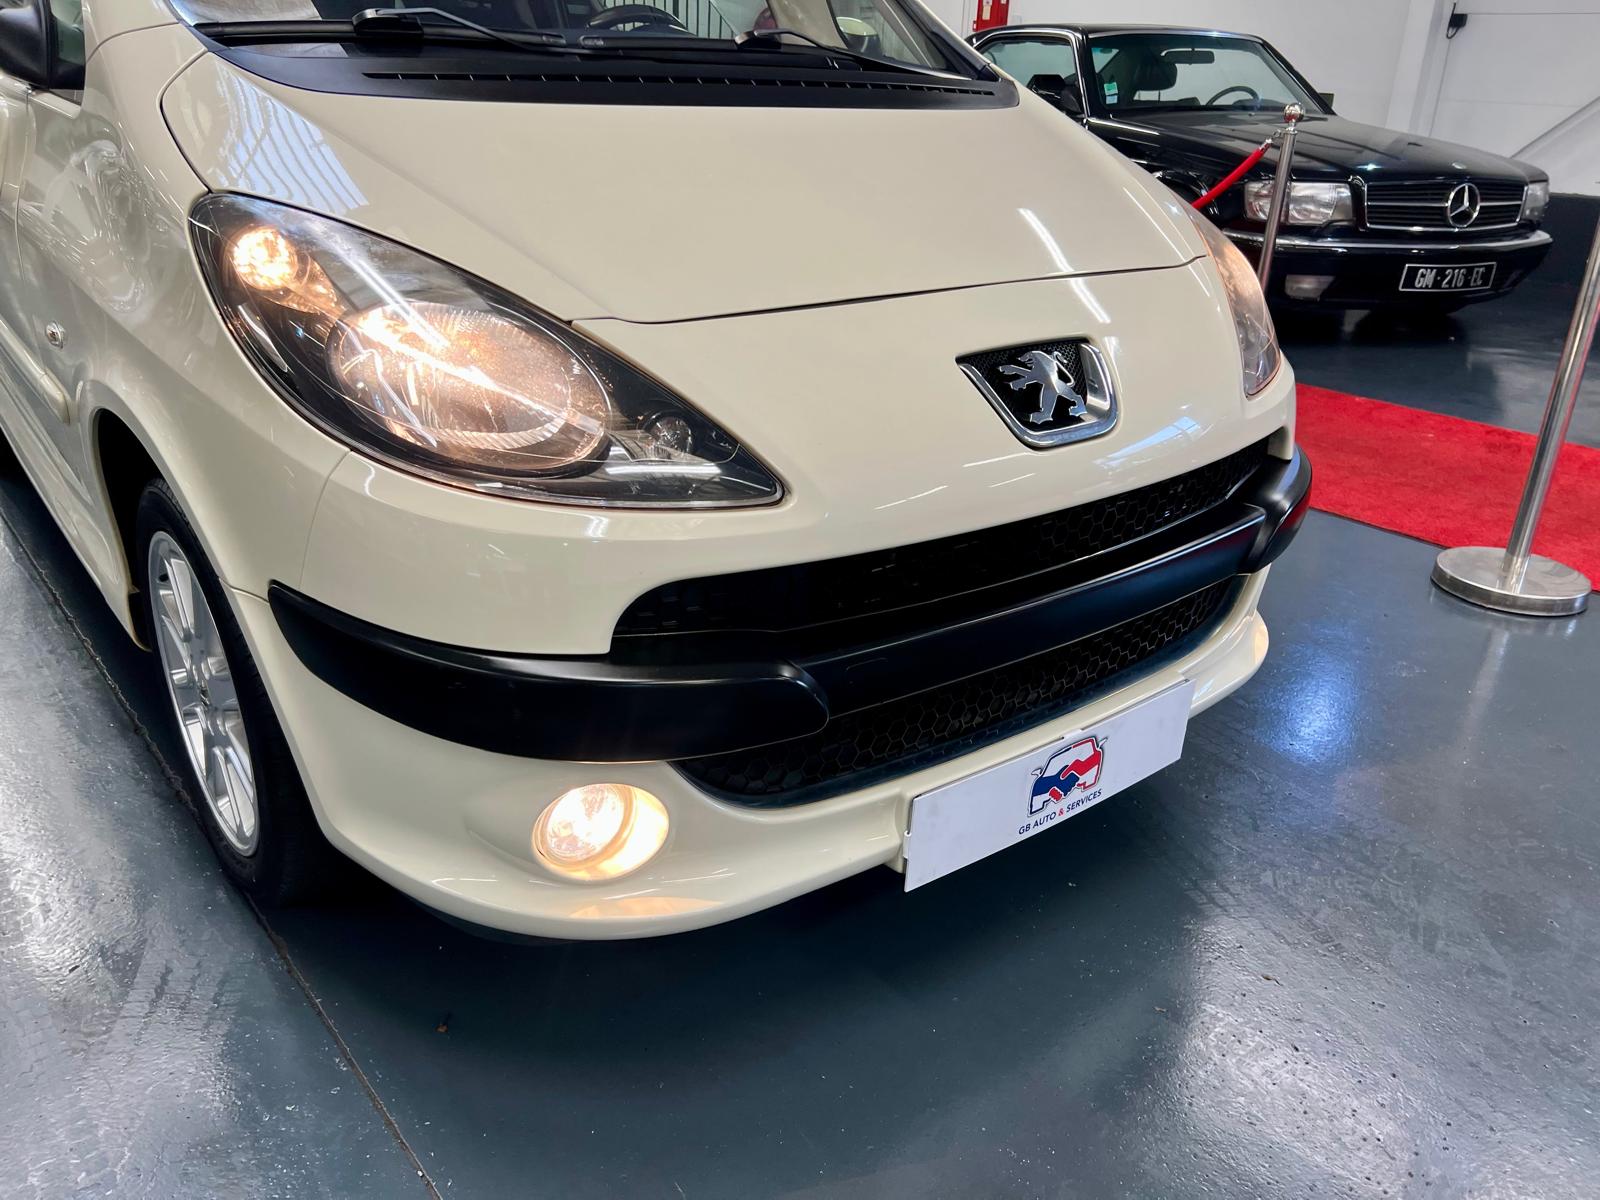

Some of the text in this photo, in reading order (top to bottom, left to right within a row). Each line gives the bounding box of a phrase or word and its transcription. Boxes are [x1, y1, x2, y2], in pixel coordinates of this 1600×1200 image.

[1018, 789, 1102, 835] GB AUTO & SERVICES
